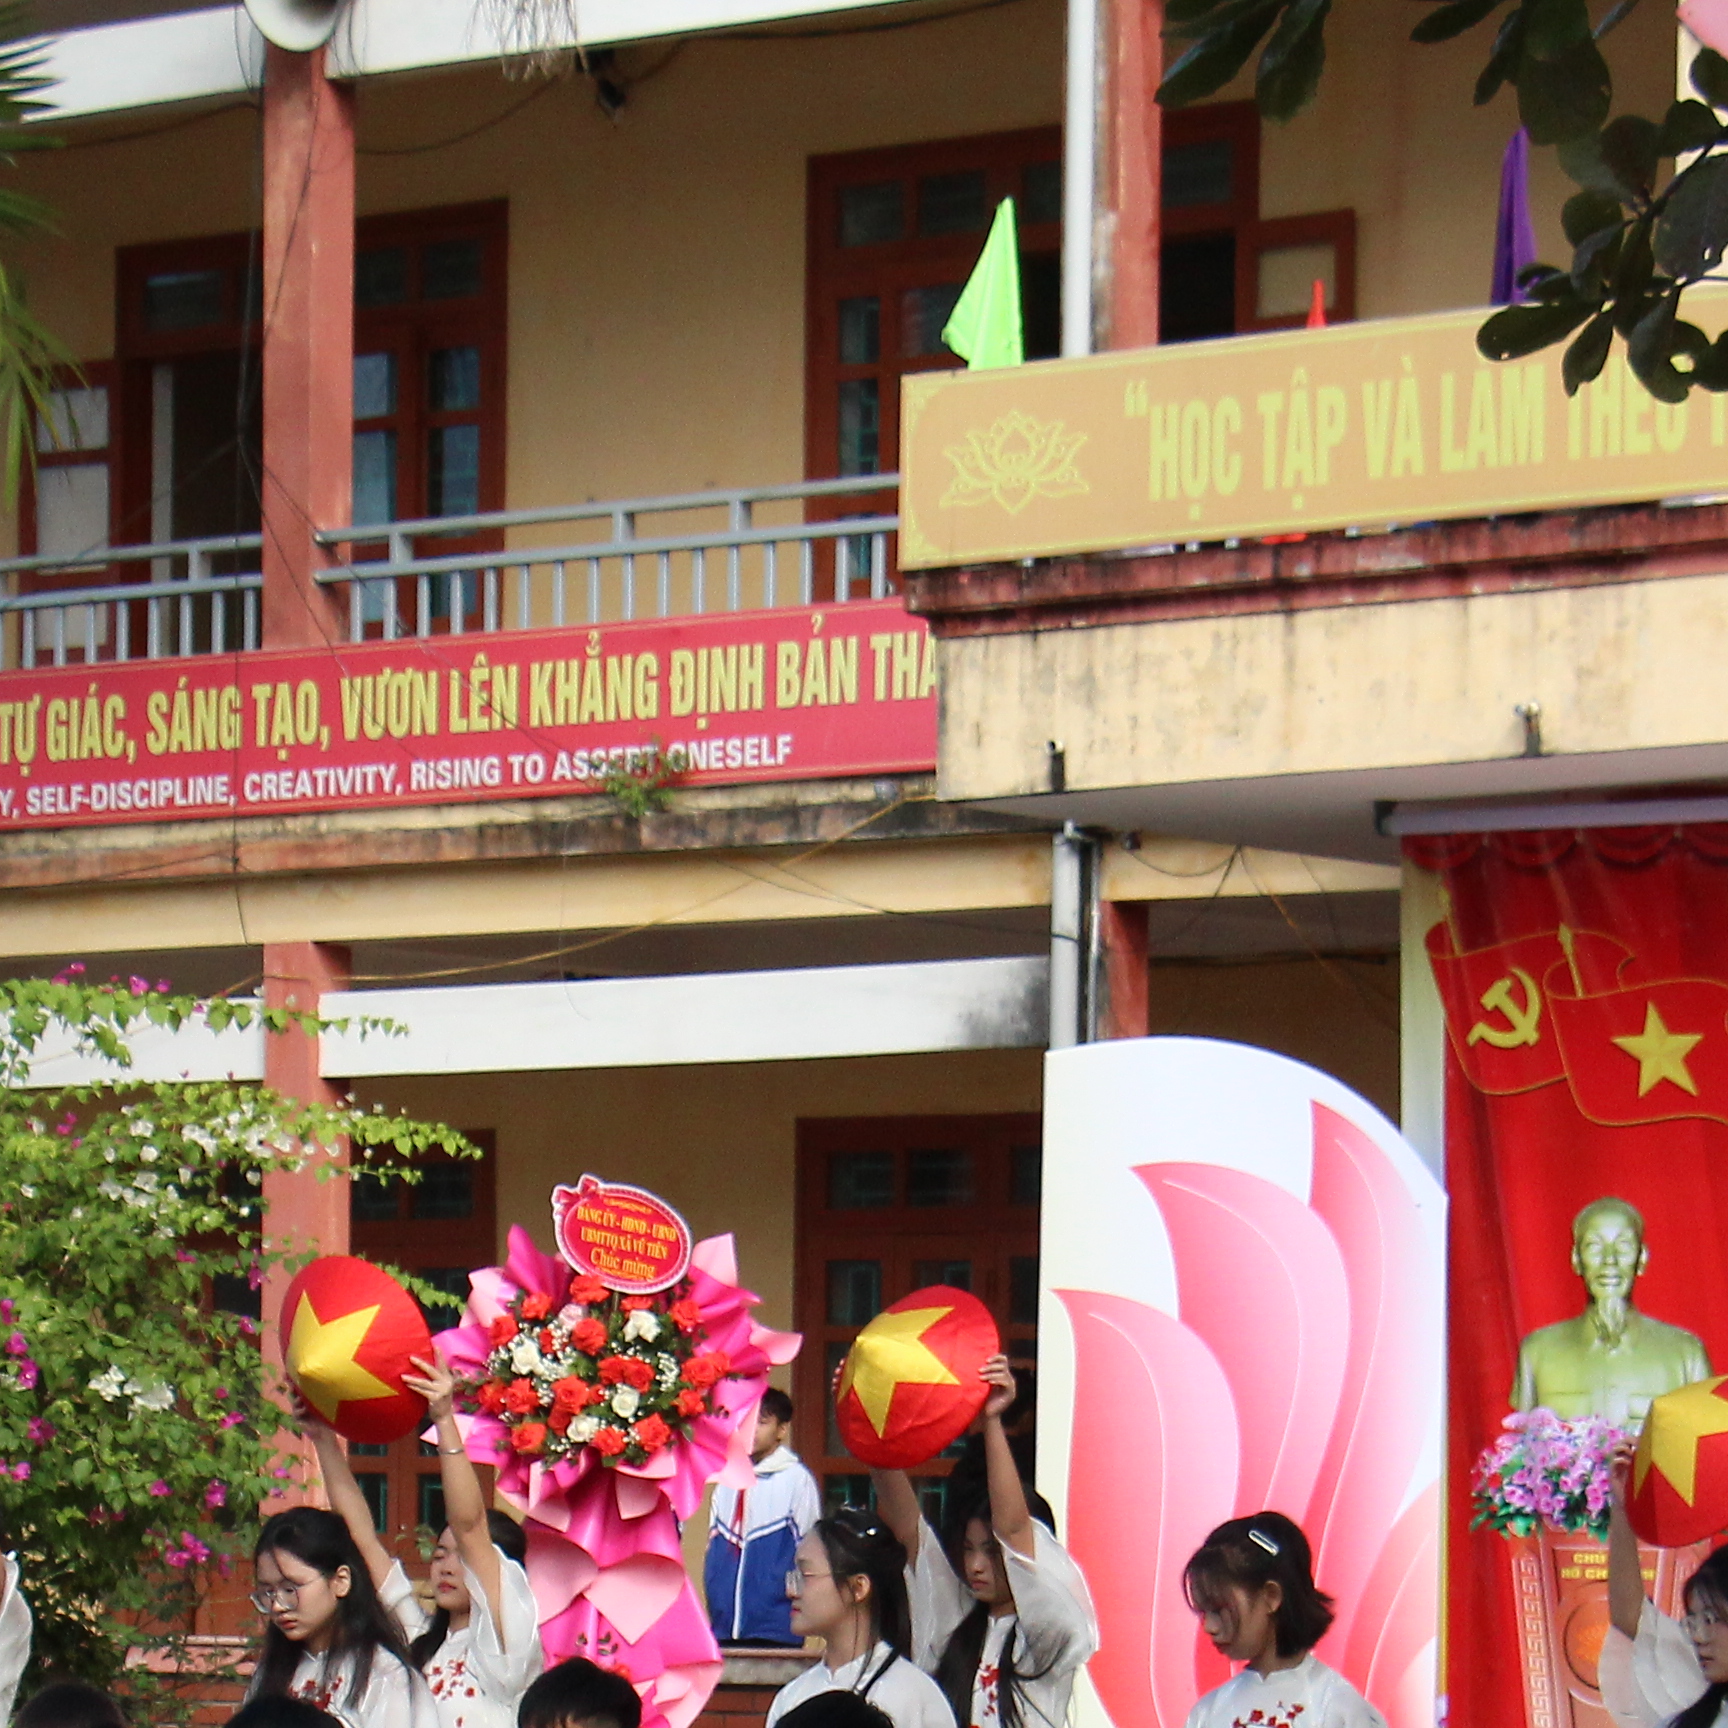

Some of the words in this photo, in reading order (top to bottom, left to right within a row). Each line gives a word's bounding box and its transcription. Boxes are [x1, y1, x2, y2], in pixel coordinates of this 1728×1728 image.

[1257, 366, 1348, 510] TẬP
[1362, 353, 1424, 479] VÀ
[46, 681, 136, 765] GIÁC,
[146, 674, 243, 756] SÁNG
[251, 678, 330, 762] TẠO,
[340, 666, 439, 742] VƯƠN
[449, 651, 520, 734] LÊN
[668, 642, 765, 731] ĐỊNH
[775, 612, 860, 710] BẢN
[25, 774, 237, 817] SELF-DISCIPLINE,
[243, 761, 403, 803] CREATIVITY,
[507, 751, 546, 786] TO
[667, 734, 793, 774] ONESELF
